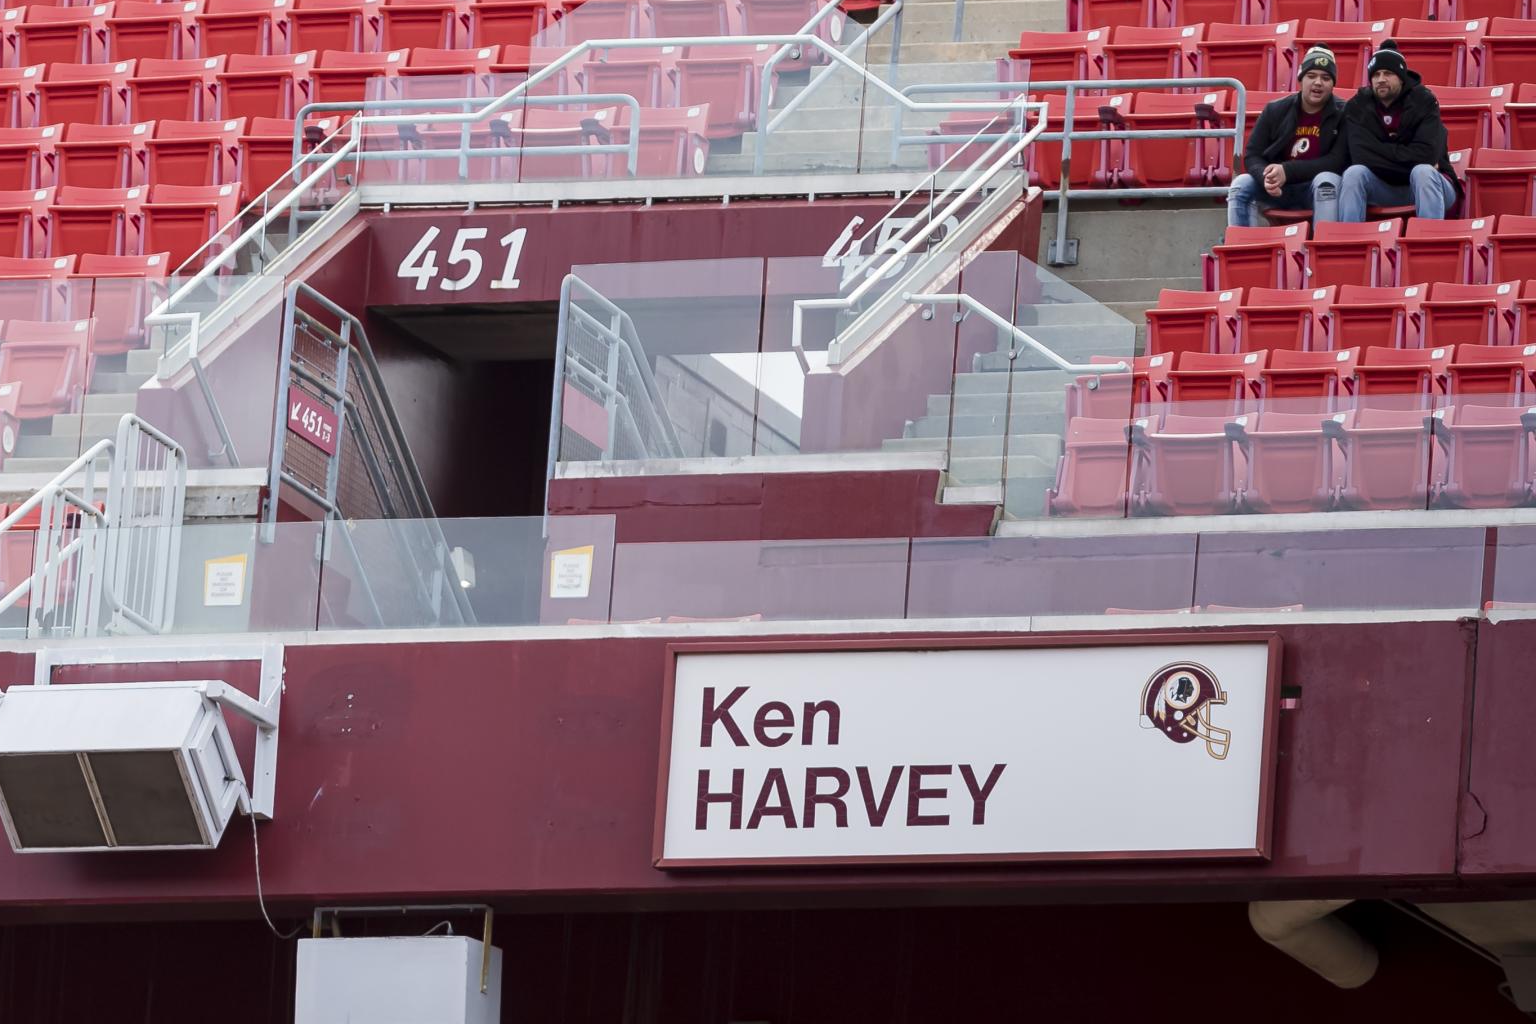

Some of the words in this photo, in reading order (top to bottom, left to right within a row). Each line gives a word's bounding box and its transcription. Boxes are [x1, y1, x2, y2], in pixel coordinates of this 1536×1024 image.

[397, 226, 528, 291] 451
[302, 407, 322, 437] 451
[699, 685, 843, 748] Ken
[695, 762, 1008, 831] HARVEY
